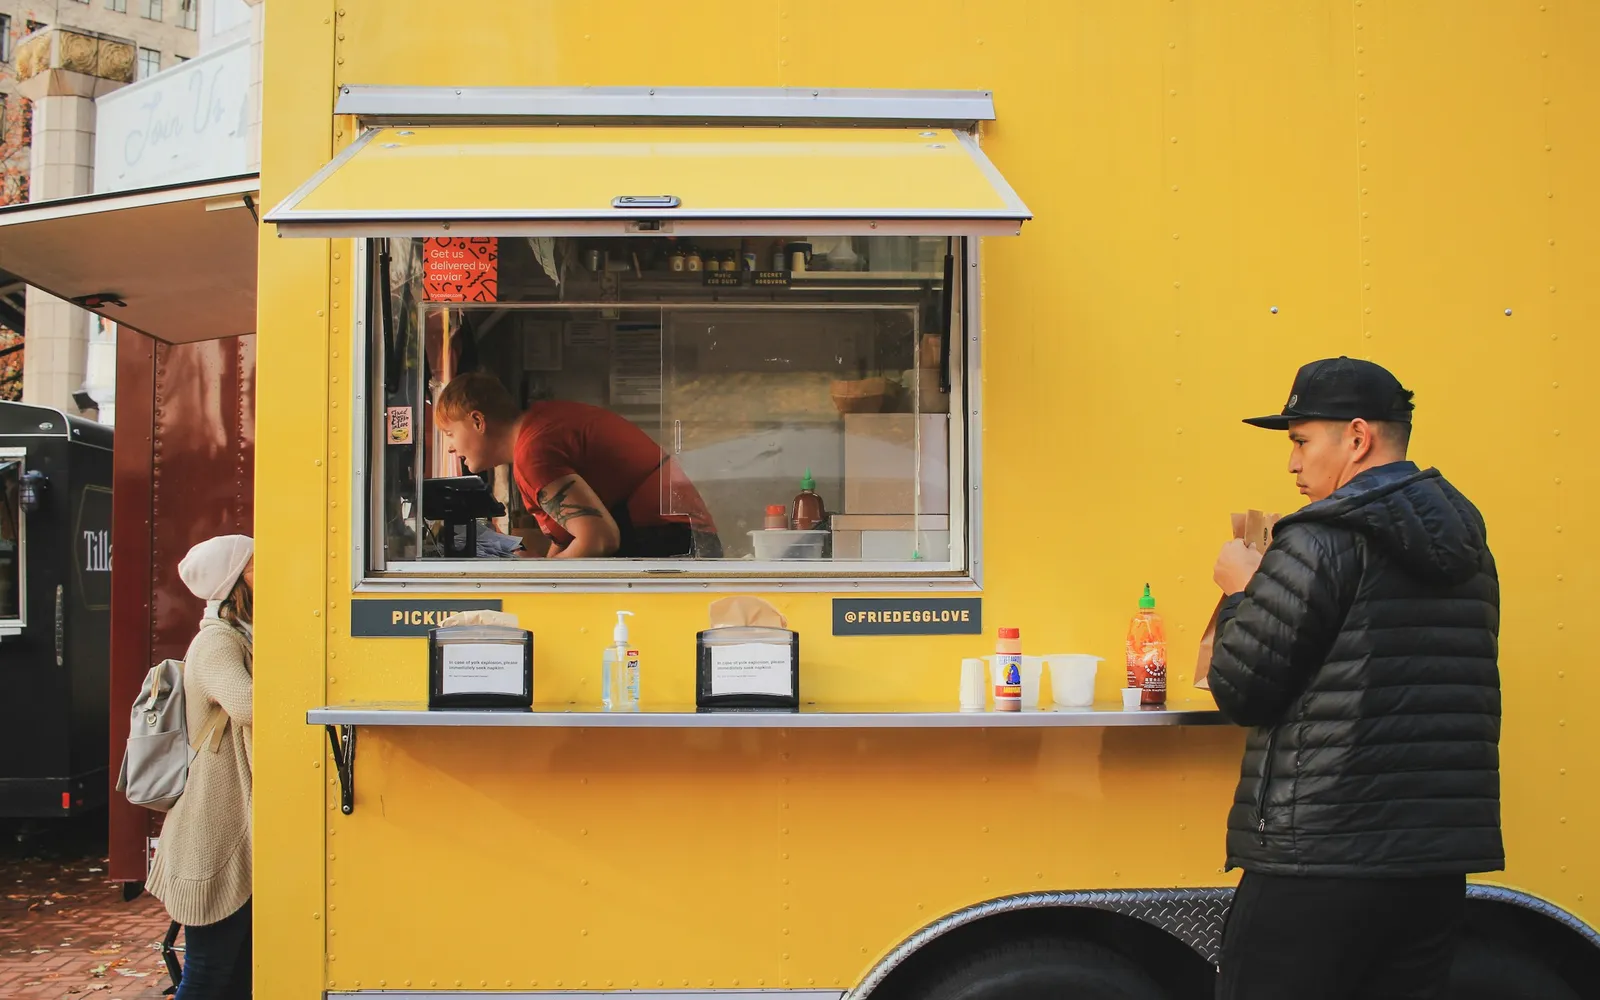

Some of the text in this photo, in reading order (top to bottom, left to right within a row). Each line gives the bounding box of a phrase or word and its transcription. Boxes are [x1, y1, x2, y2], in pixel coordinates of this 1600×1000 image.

[430, 249, 464, 259] Get us
[430, 261, 491, 272] delivered by
[430, 272, 463, 281] caviar
[844, 610, 970, 623] @FRIEDEGGLOVE
